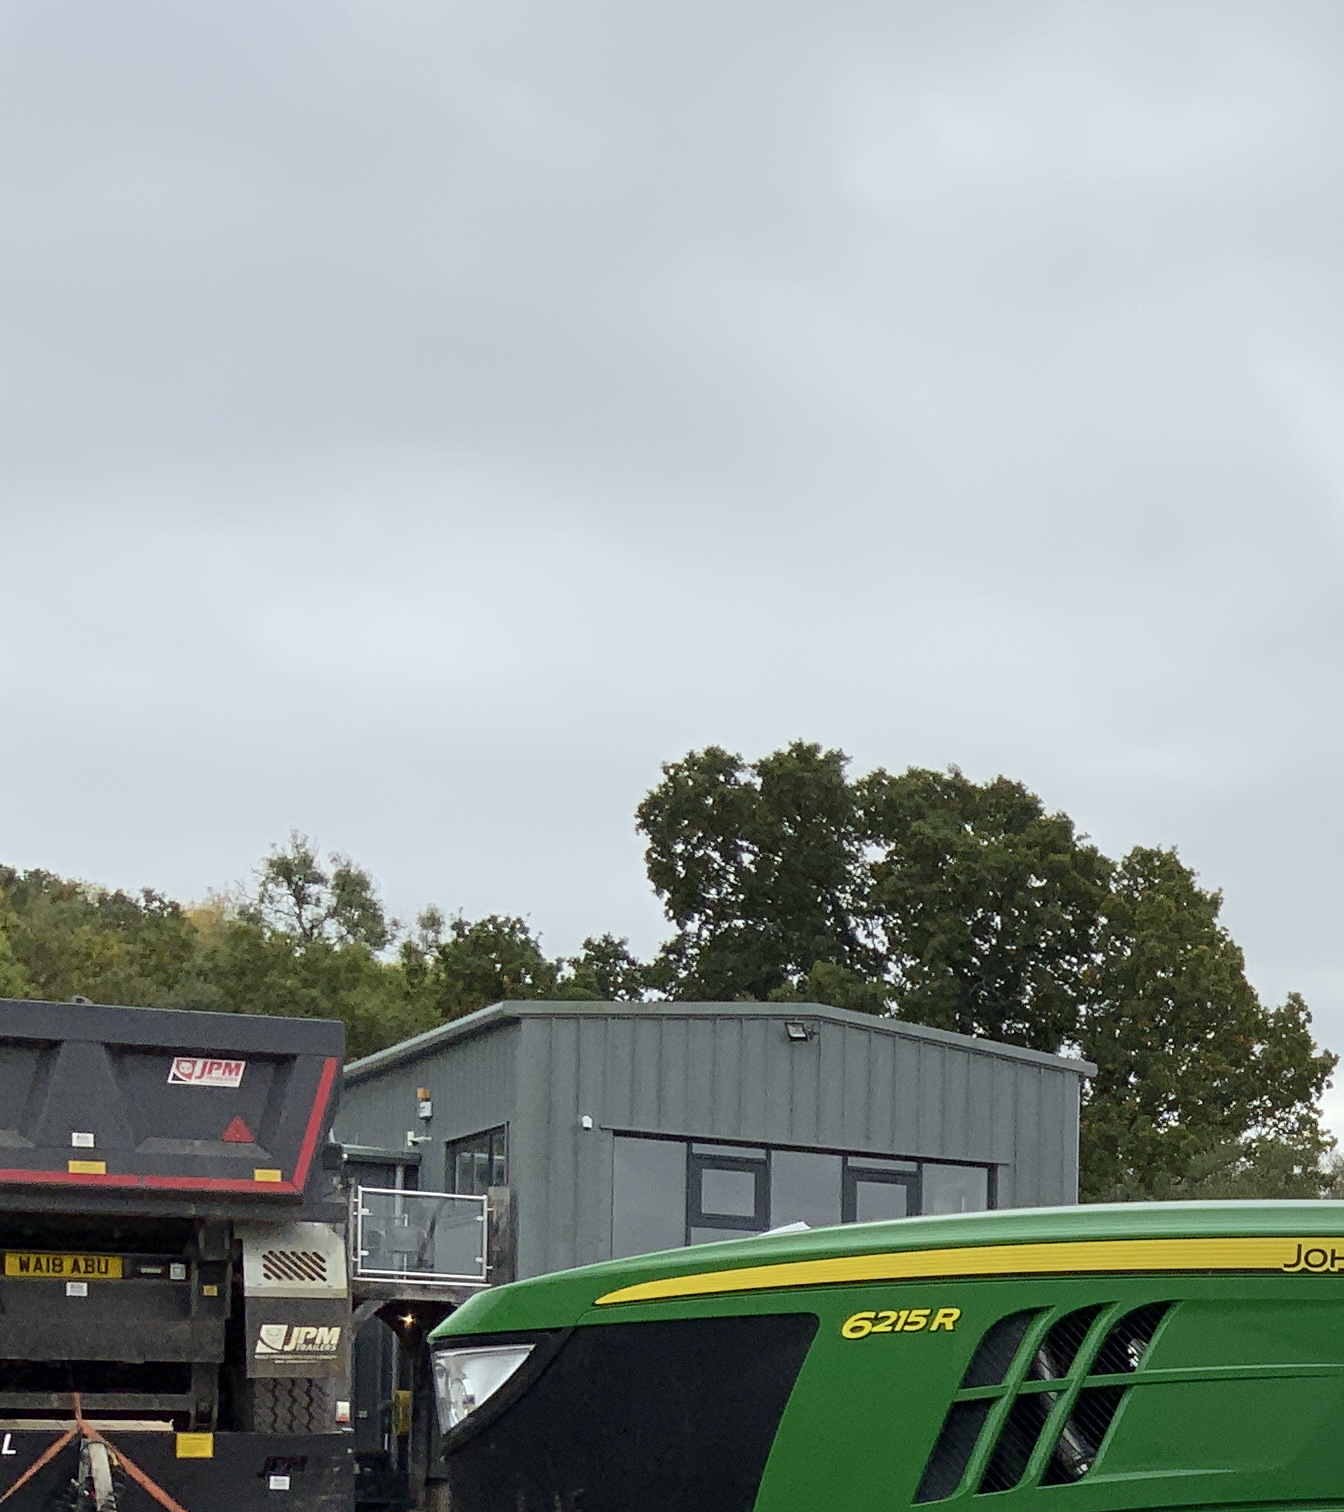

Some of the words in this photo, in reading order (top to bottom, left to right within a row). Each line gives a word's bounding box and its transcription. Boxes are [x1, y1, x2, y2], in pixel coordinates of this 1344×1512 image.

[195, 1060, 243, 1080] JPM
[18, 1255, 64, 1272] WA18
[70, 1257, 109, 1274] ABU
[283, 1325, 342, 1352] JPM
